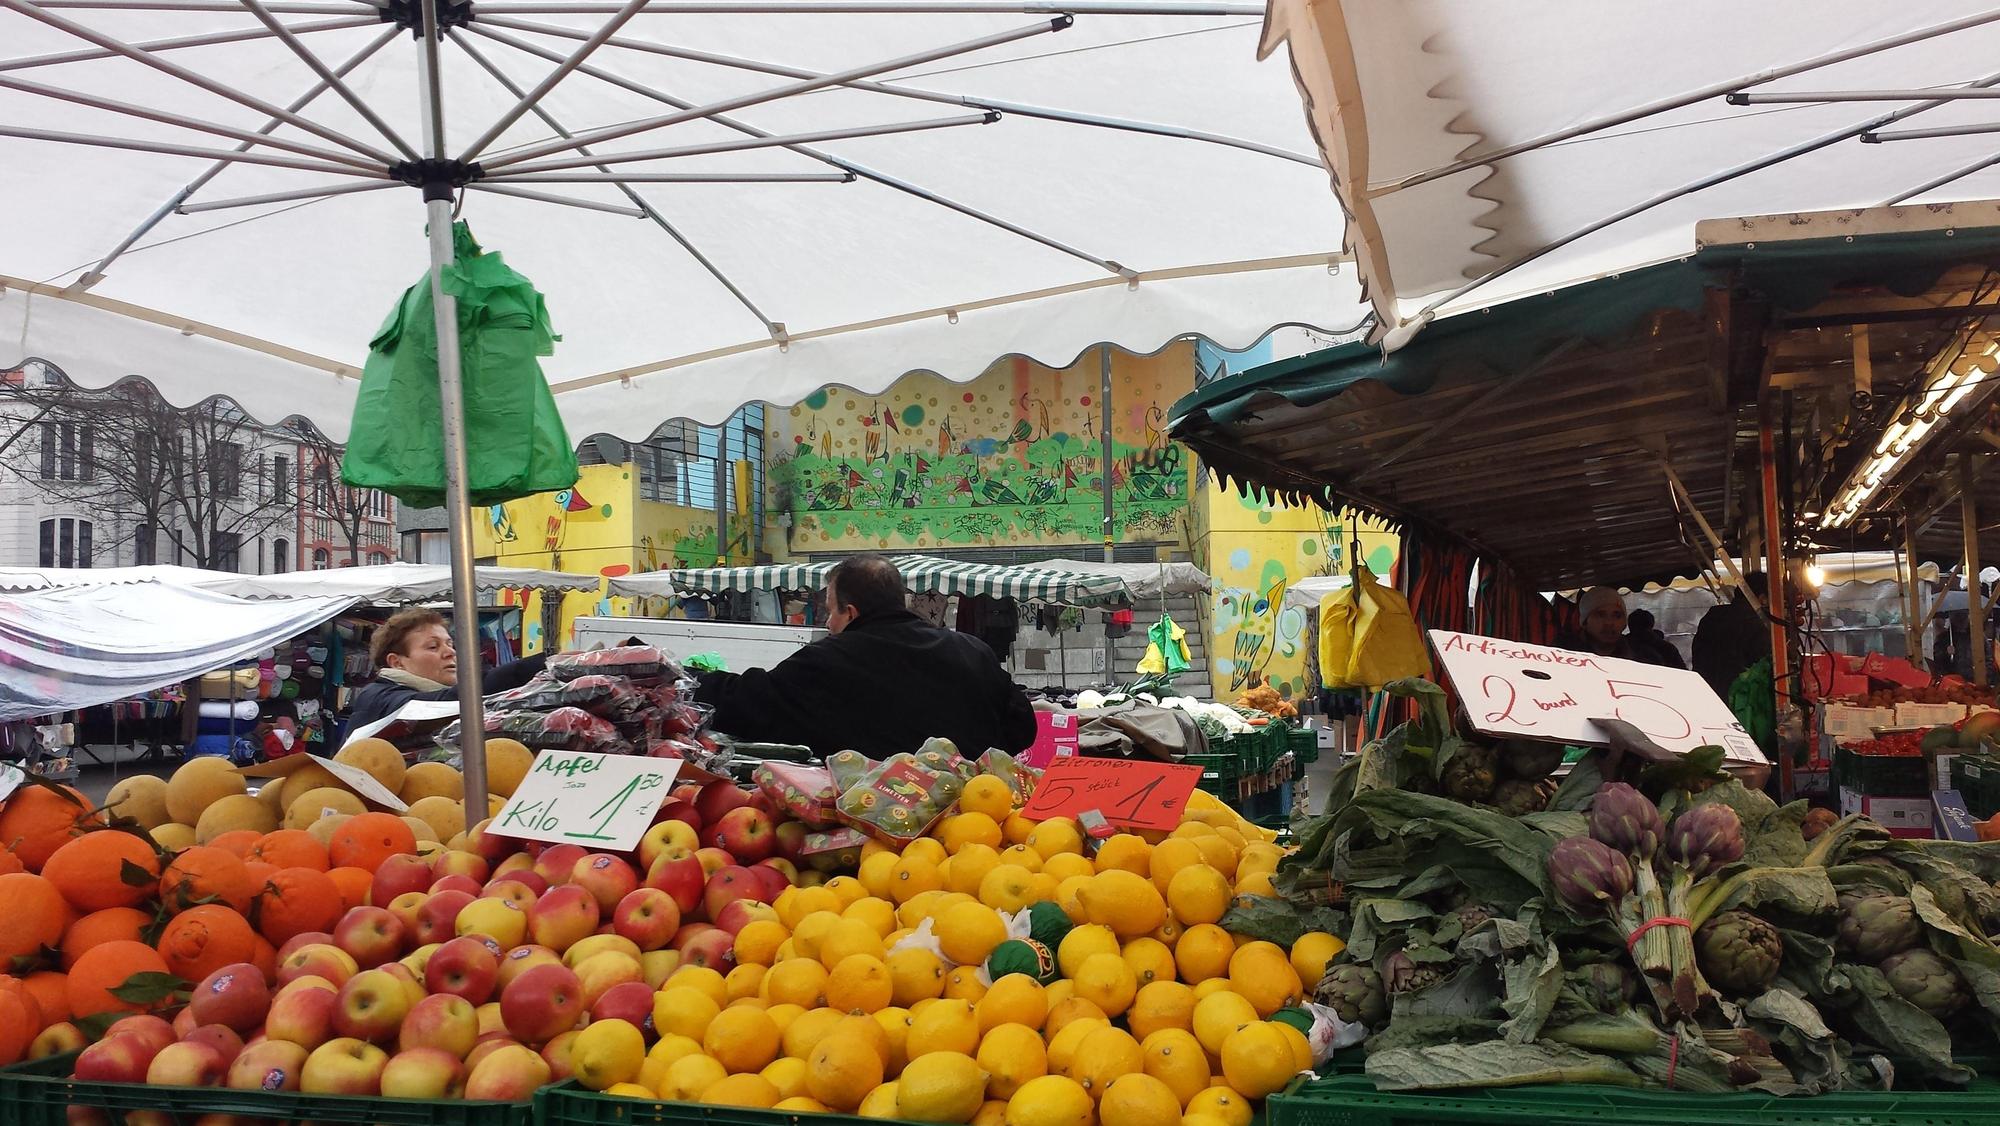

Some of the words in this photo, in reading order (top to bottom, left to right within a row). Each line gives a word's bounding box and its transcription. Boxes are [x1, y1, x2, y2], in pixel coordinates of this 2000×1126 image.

[1444, 633, 1609, 674] Artischoken
[1482, 674, 1537, 727] 2
[1532, 692, 1579, 712] bund
[1606, 679, 1691, 740] 5
[534, 754, 607, 777] Apfel
[1050, 757, 1133, 769] Zitronen
[877, 784, 911, 804] LIMETTEN
[1032, 776, 1089, 811] 5
[1114, 775, 1167, 825] 1
[501, 798, 559, 831] Kilo
